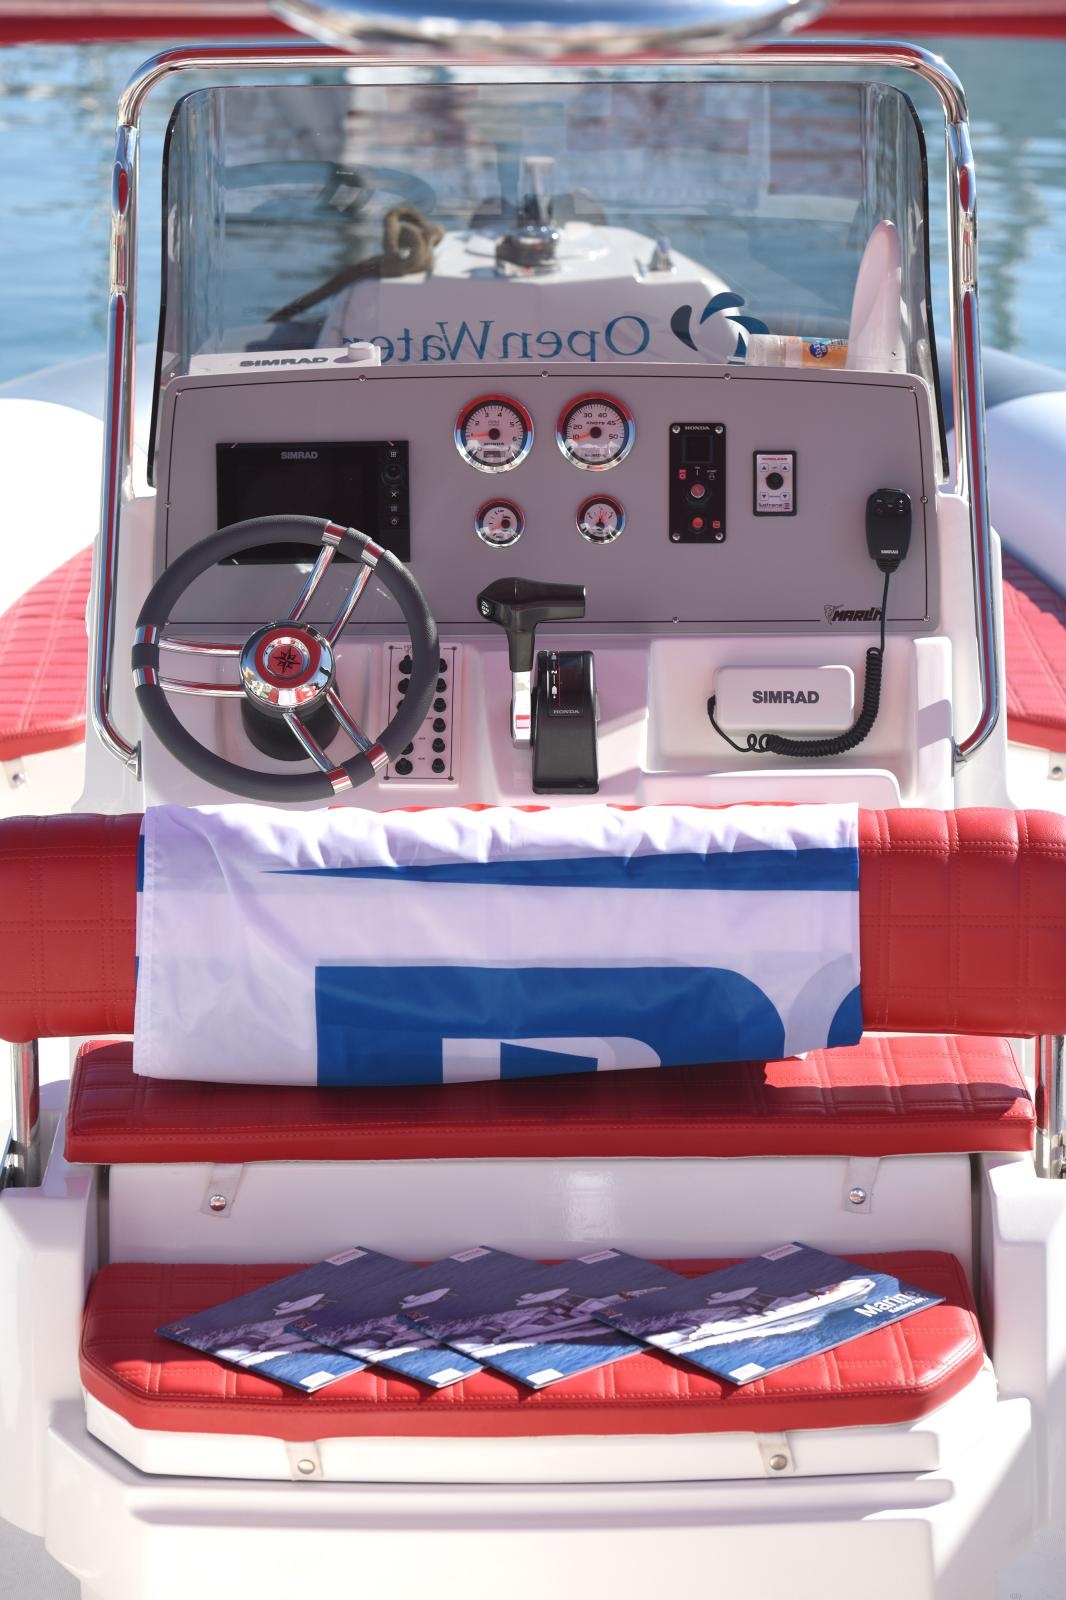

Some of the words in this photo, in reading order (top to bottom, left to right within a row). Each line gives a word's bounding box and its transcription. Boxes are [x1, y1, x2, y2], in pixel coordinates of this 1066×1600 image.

[239, 356, 329, 368] SIMRAD
[280, 451, 319, 460] SIMRAD
[752, 690, 820, 704] SIMRAD
